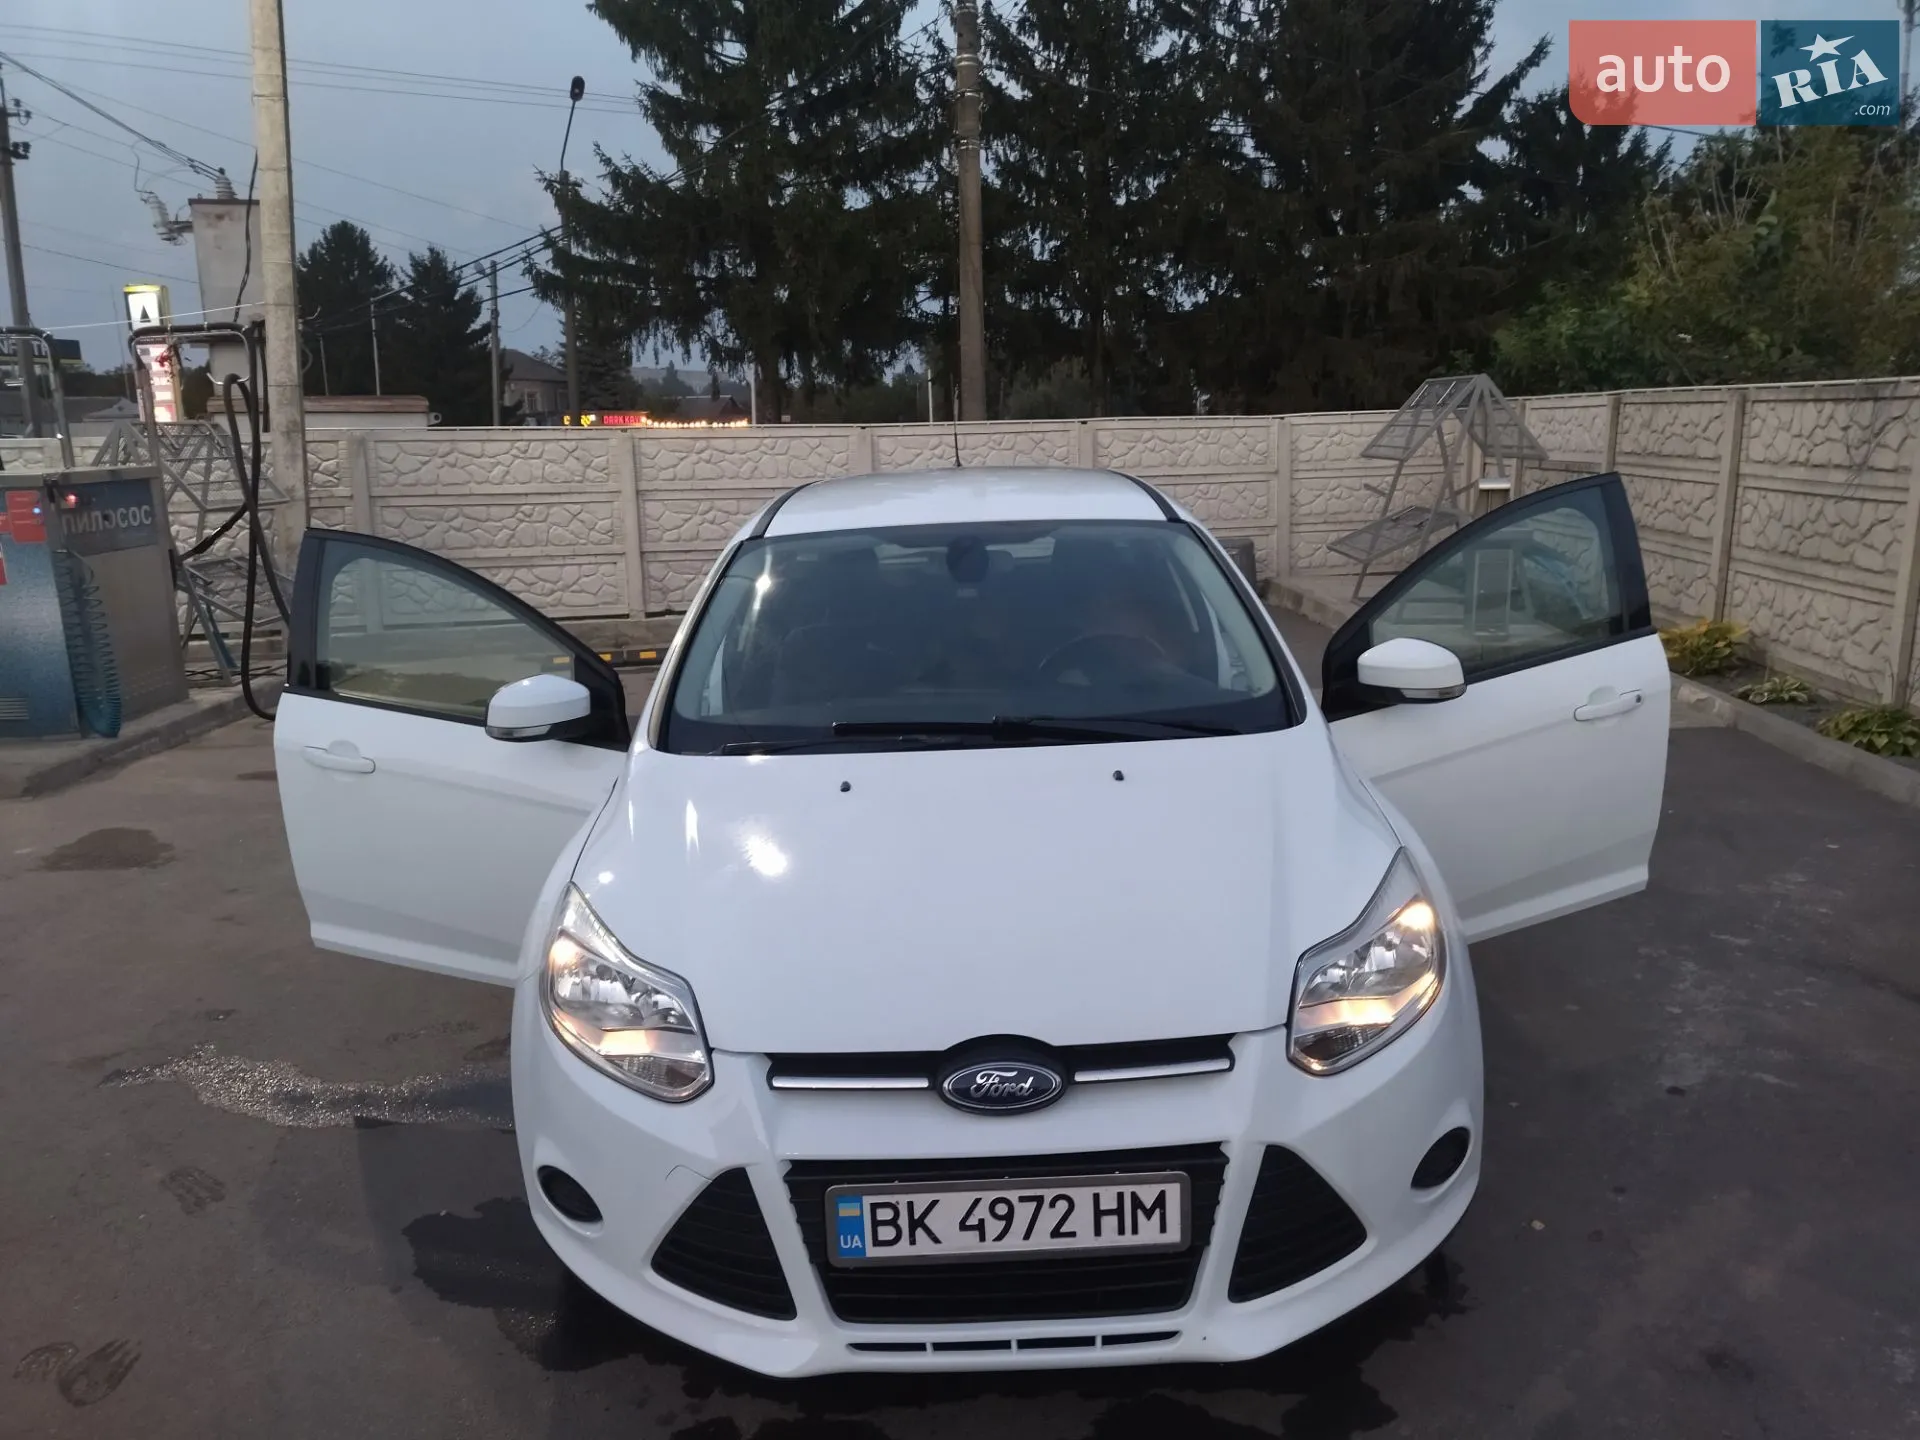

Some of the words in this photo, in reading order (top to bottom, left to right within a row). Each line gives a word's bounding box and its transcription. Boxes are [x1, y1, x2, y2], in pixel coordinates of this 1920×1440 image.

[62, 505, 152, 535] ПИЛОСОС
[970, 1070, 1034, 1098] Ford
[869, 1199, 942, 1248] BK
[958, 1194, 1077, 1243] 4972
[1092, 1189, 1167, 1237] HM
[840, 1234, 862, 1249] UA
